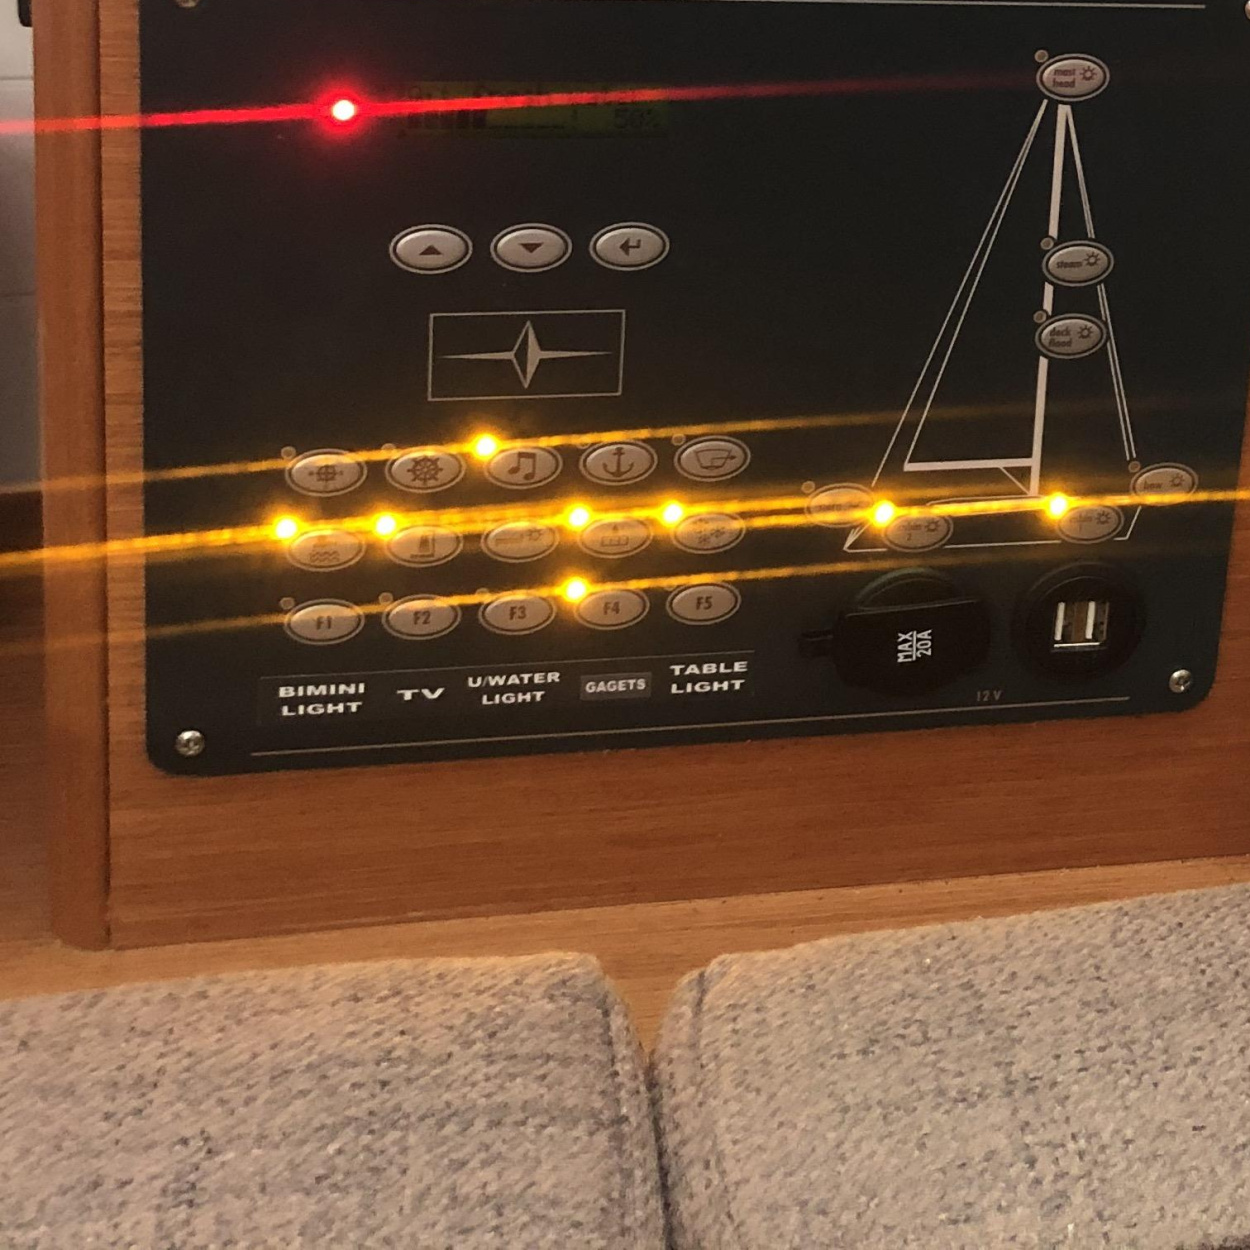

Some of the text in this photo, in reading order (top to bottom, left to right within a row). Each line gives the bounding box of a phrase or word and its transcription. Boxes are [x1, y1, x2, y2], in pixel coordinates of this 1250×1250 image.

[603, 600, 621, 617] F4
[695, 595, 713, 611] F5
[412, 610, 432, 626] F2
[509, 604, 527, 621] F3
[315, 615, 333, 631] F1
[897, 631, 914, 664] MAX
[916, 629, 933, 657] 20A
[670, 661, 748, 677] TABLE
[467, 671, 561, 689] U/WATER
[585, 677, 646, 693] GAGETS
[670, 679, 746, 695] LIGHT
[278, 682, 366, 699] BIMINI
[396, 687, 446, 701] TV
[481, 690, 545, 706] LIGHT
[280, 701, 363, 717] LIGHT
